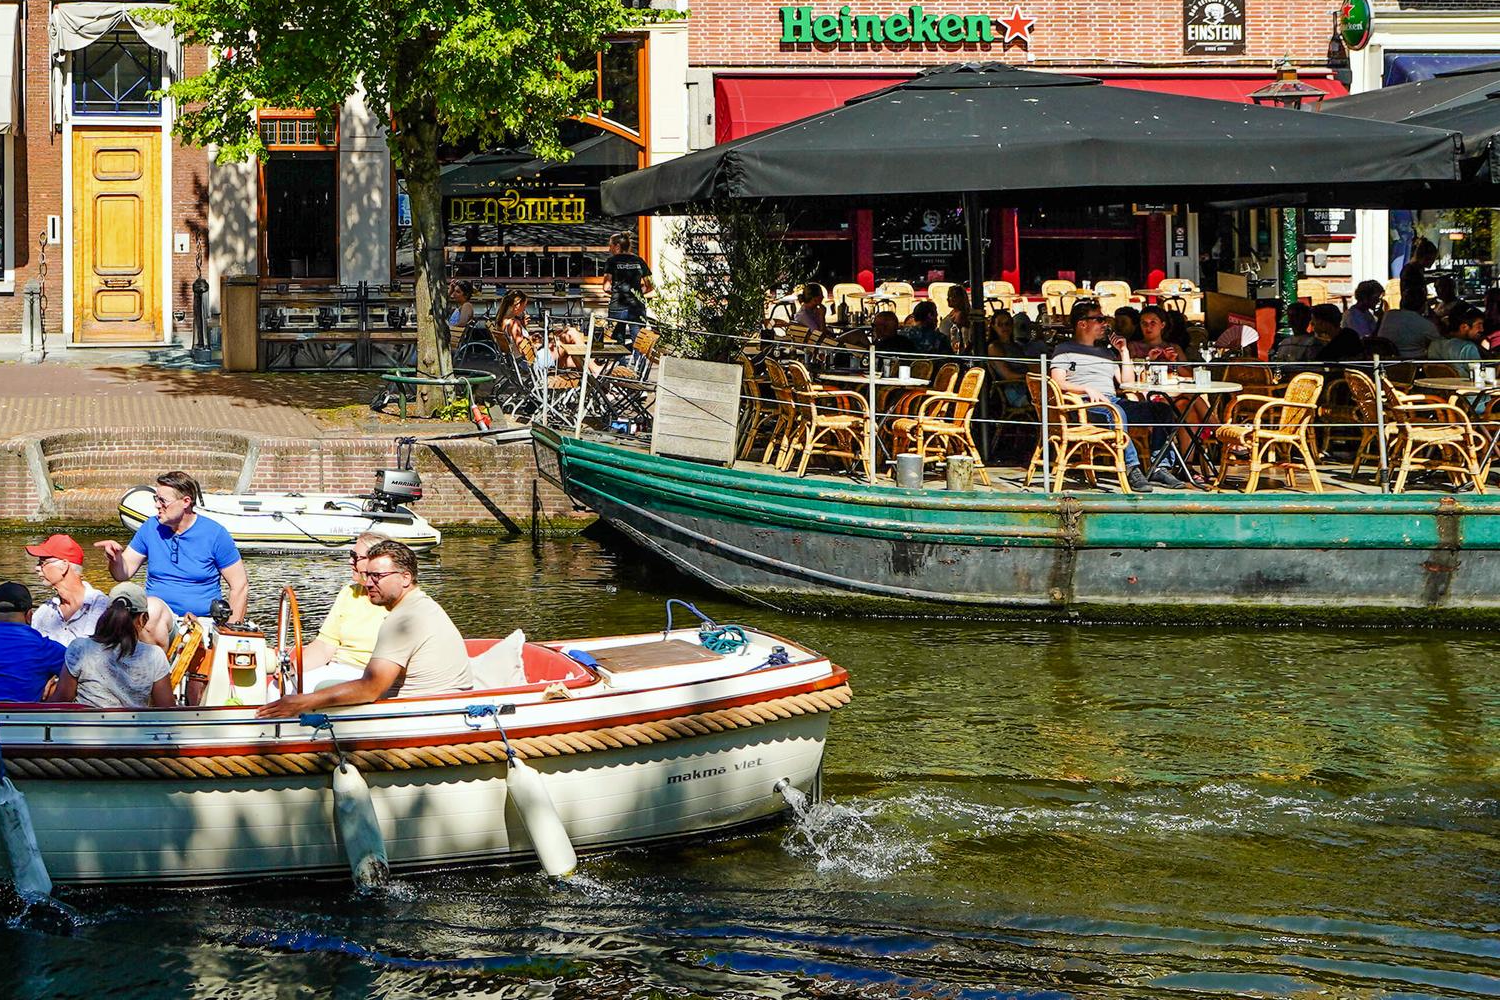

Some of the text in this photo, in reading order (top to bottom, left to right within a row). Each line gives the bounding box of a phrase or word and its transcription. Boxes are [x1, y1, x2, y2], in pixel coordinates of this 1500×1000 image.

[779, 5, 995, 43] Heineken
[1187, 24, 1242, 41] EINSTEIN
[451, 198, 475, 223] DE
[902, 234, 963, 251] EINSTEIN
[391, 480, 421, 488] MARINER
[734, 758, 763, 771] vlet
